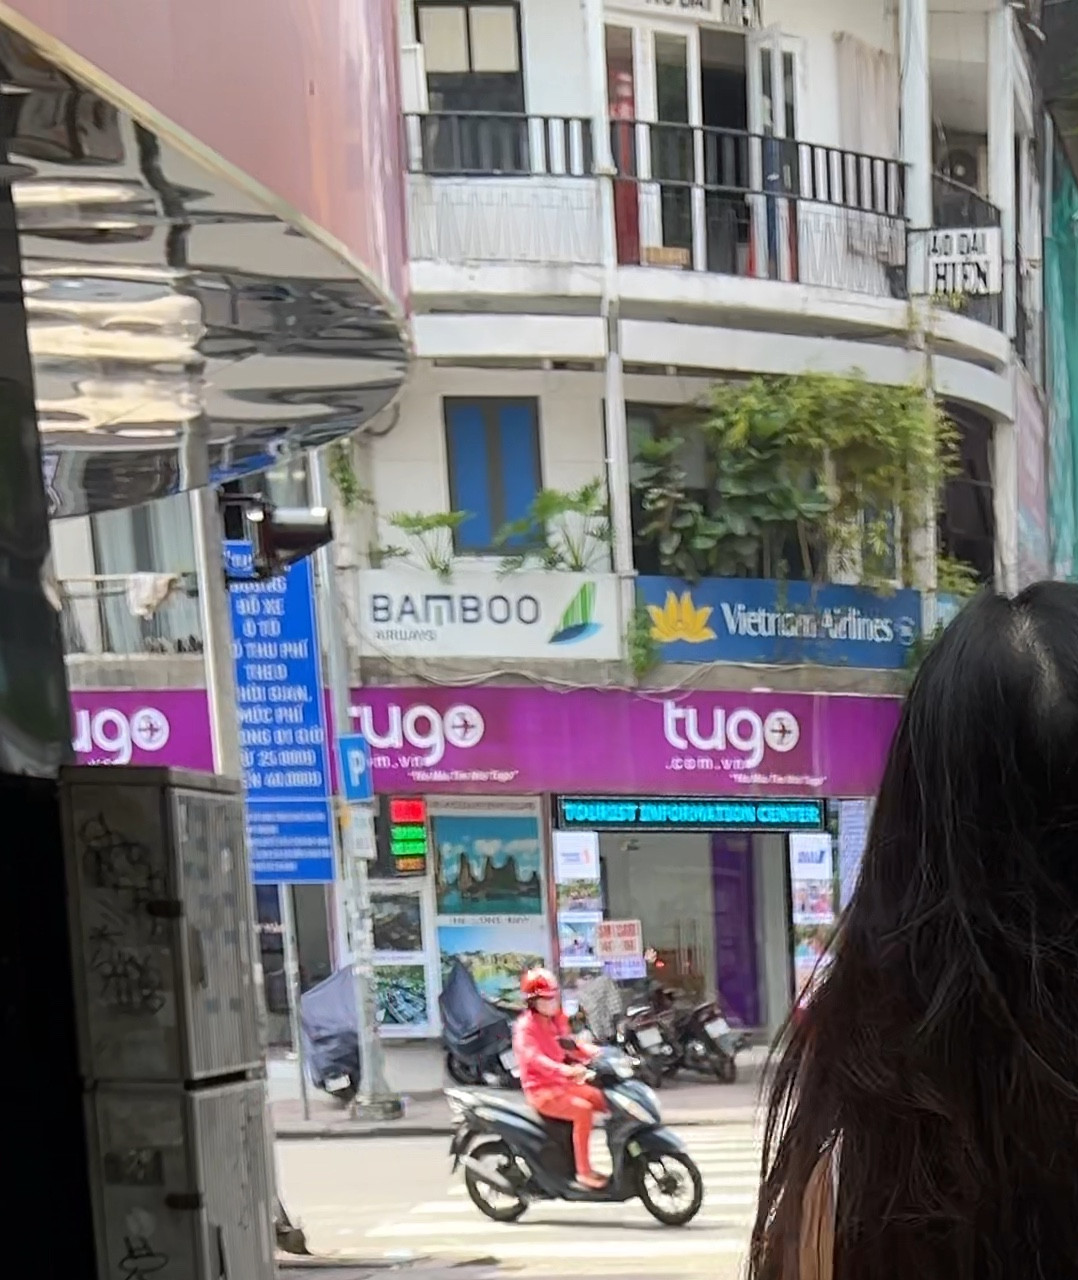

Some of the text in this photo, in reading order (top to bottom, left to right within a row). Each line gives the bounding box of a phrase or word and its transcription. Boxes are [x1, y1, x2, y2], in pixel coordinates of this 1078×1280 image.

[372, 594, 540, 625] BAMBOO
[720, 602, 893, 643] Vietnam Airlines
[347, 704, 485, 767] ugo
[663, 699, 800, 768] tugo
[348, 750, 365, 787] P
[563, 802, 819, 823] TOURIST INFORMATION CENTER
